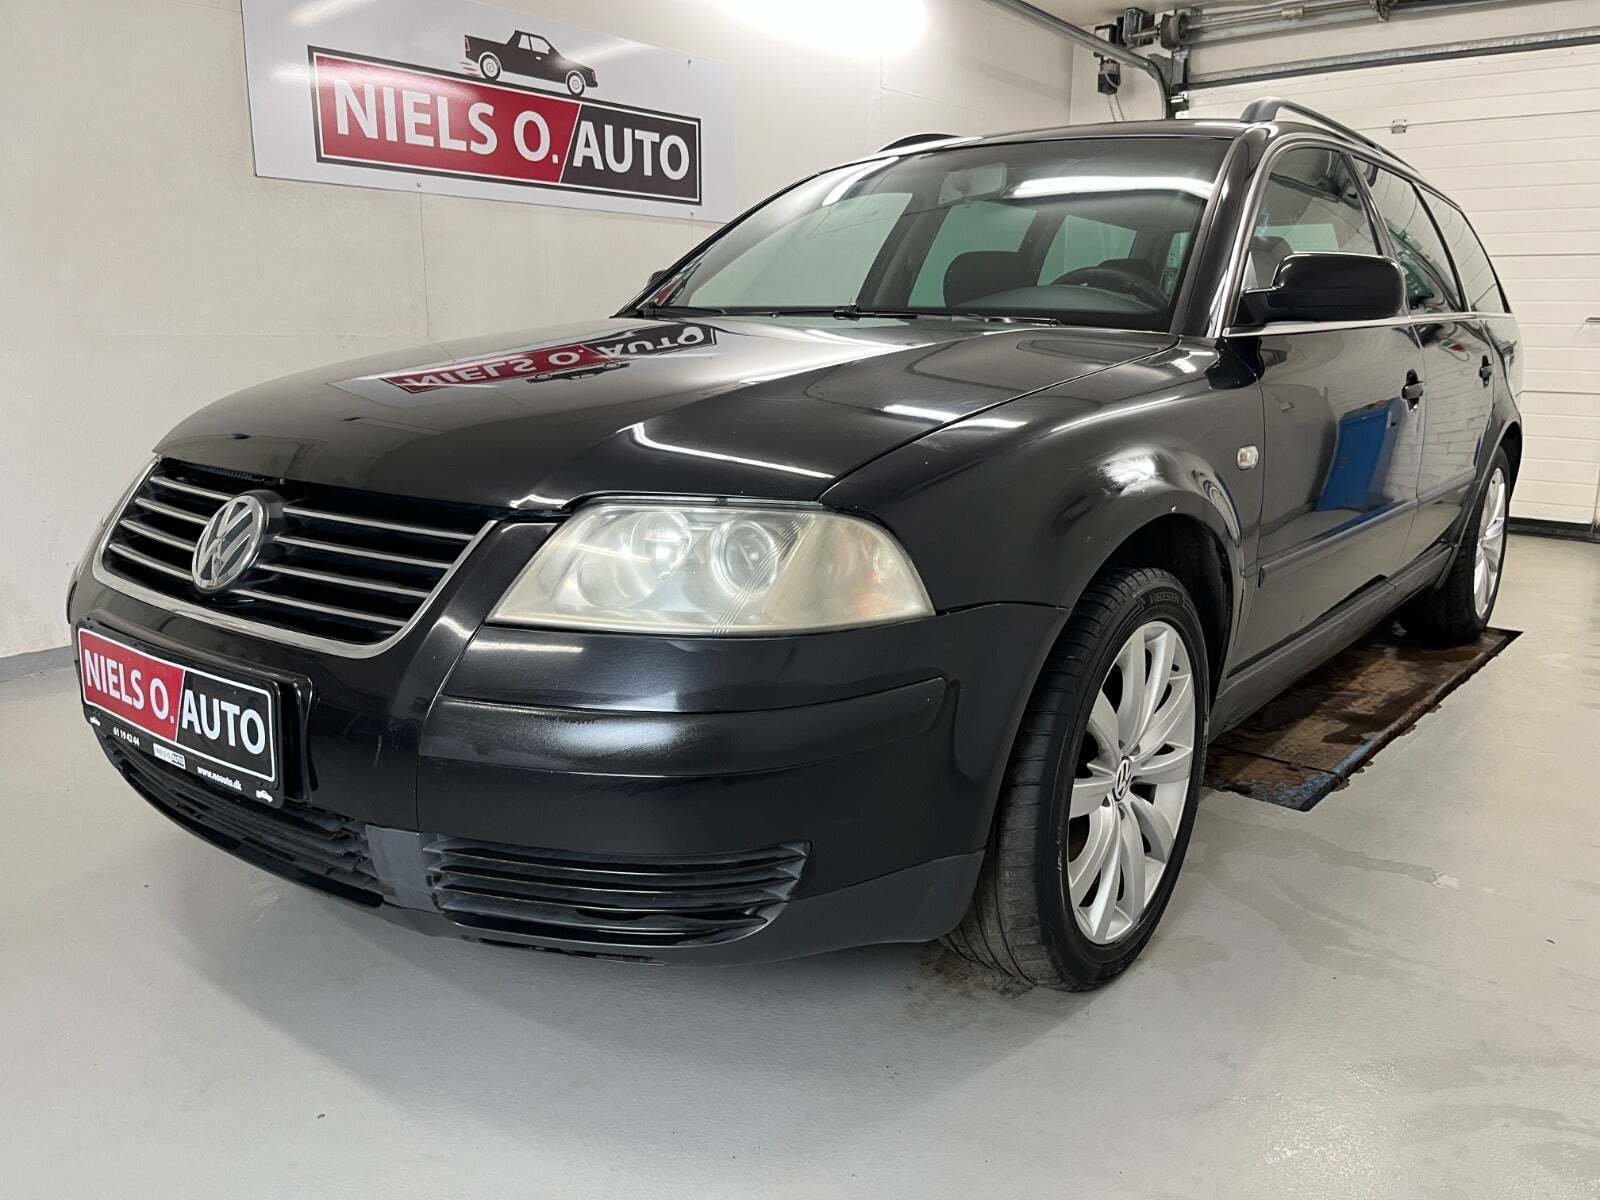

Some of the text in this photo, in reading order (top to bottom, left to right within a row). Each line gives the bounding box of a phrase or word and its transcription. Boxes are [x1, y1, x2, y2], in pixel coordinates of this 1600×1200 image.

[333, 79, 690, 181] NIELS O. AUTO
[84, 649, 266, 755] NIELS O. AUTO
